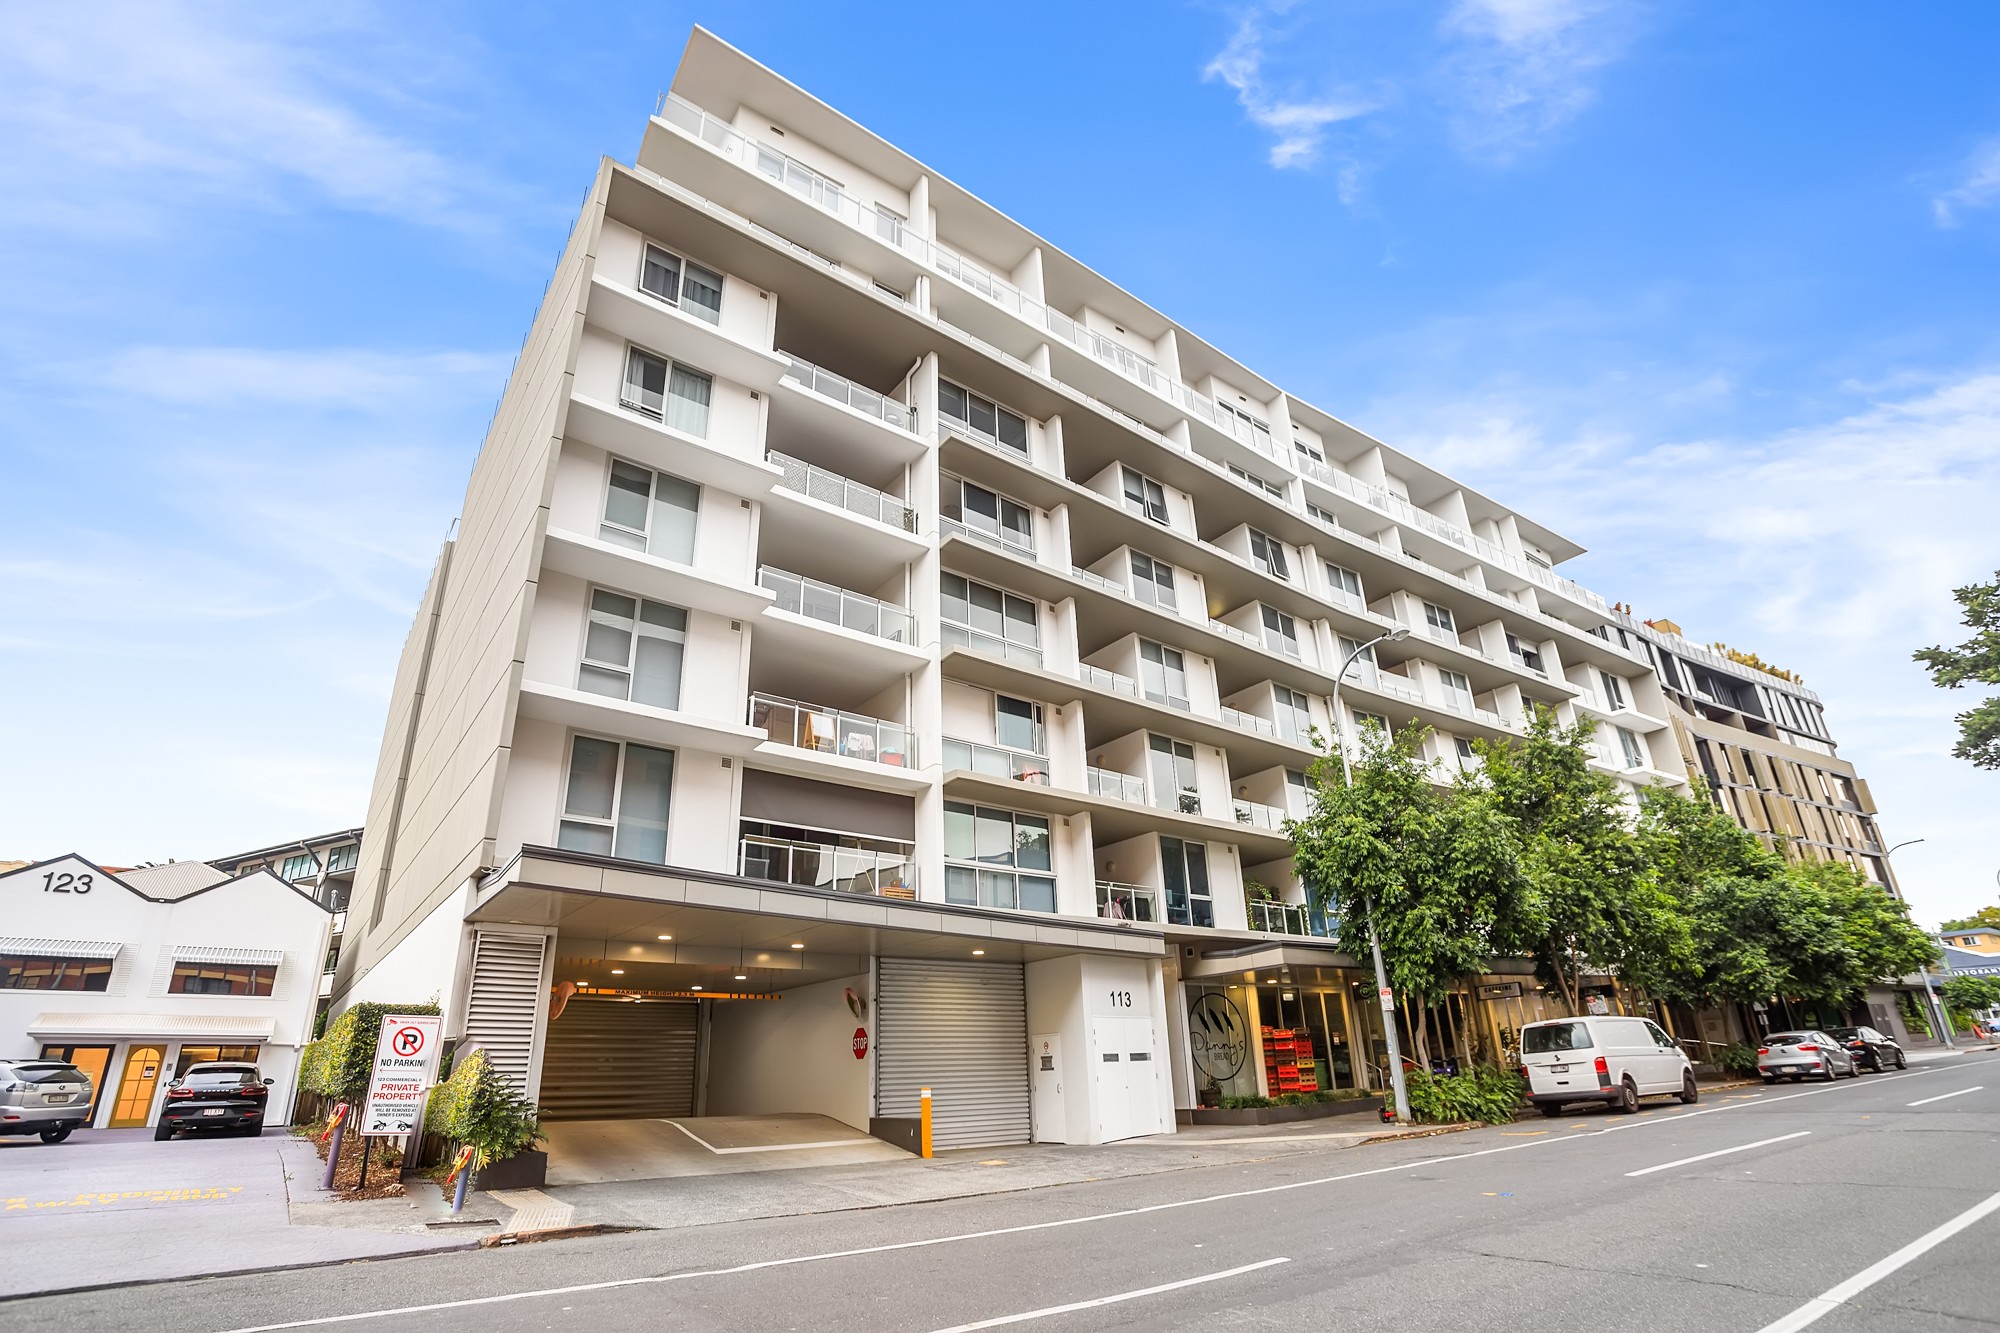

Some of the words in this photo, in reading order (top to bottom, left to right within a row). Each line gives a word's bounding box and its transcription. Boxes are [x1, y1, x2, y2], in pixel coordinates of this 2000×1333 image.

[43, 871, 93, 894] 123
[1110, 991, 1131, 1007] 113
[853, 1037, 868, 1050] STOP
[1190, 1032, 1243, 1066] Danny's
